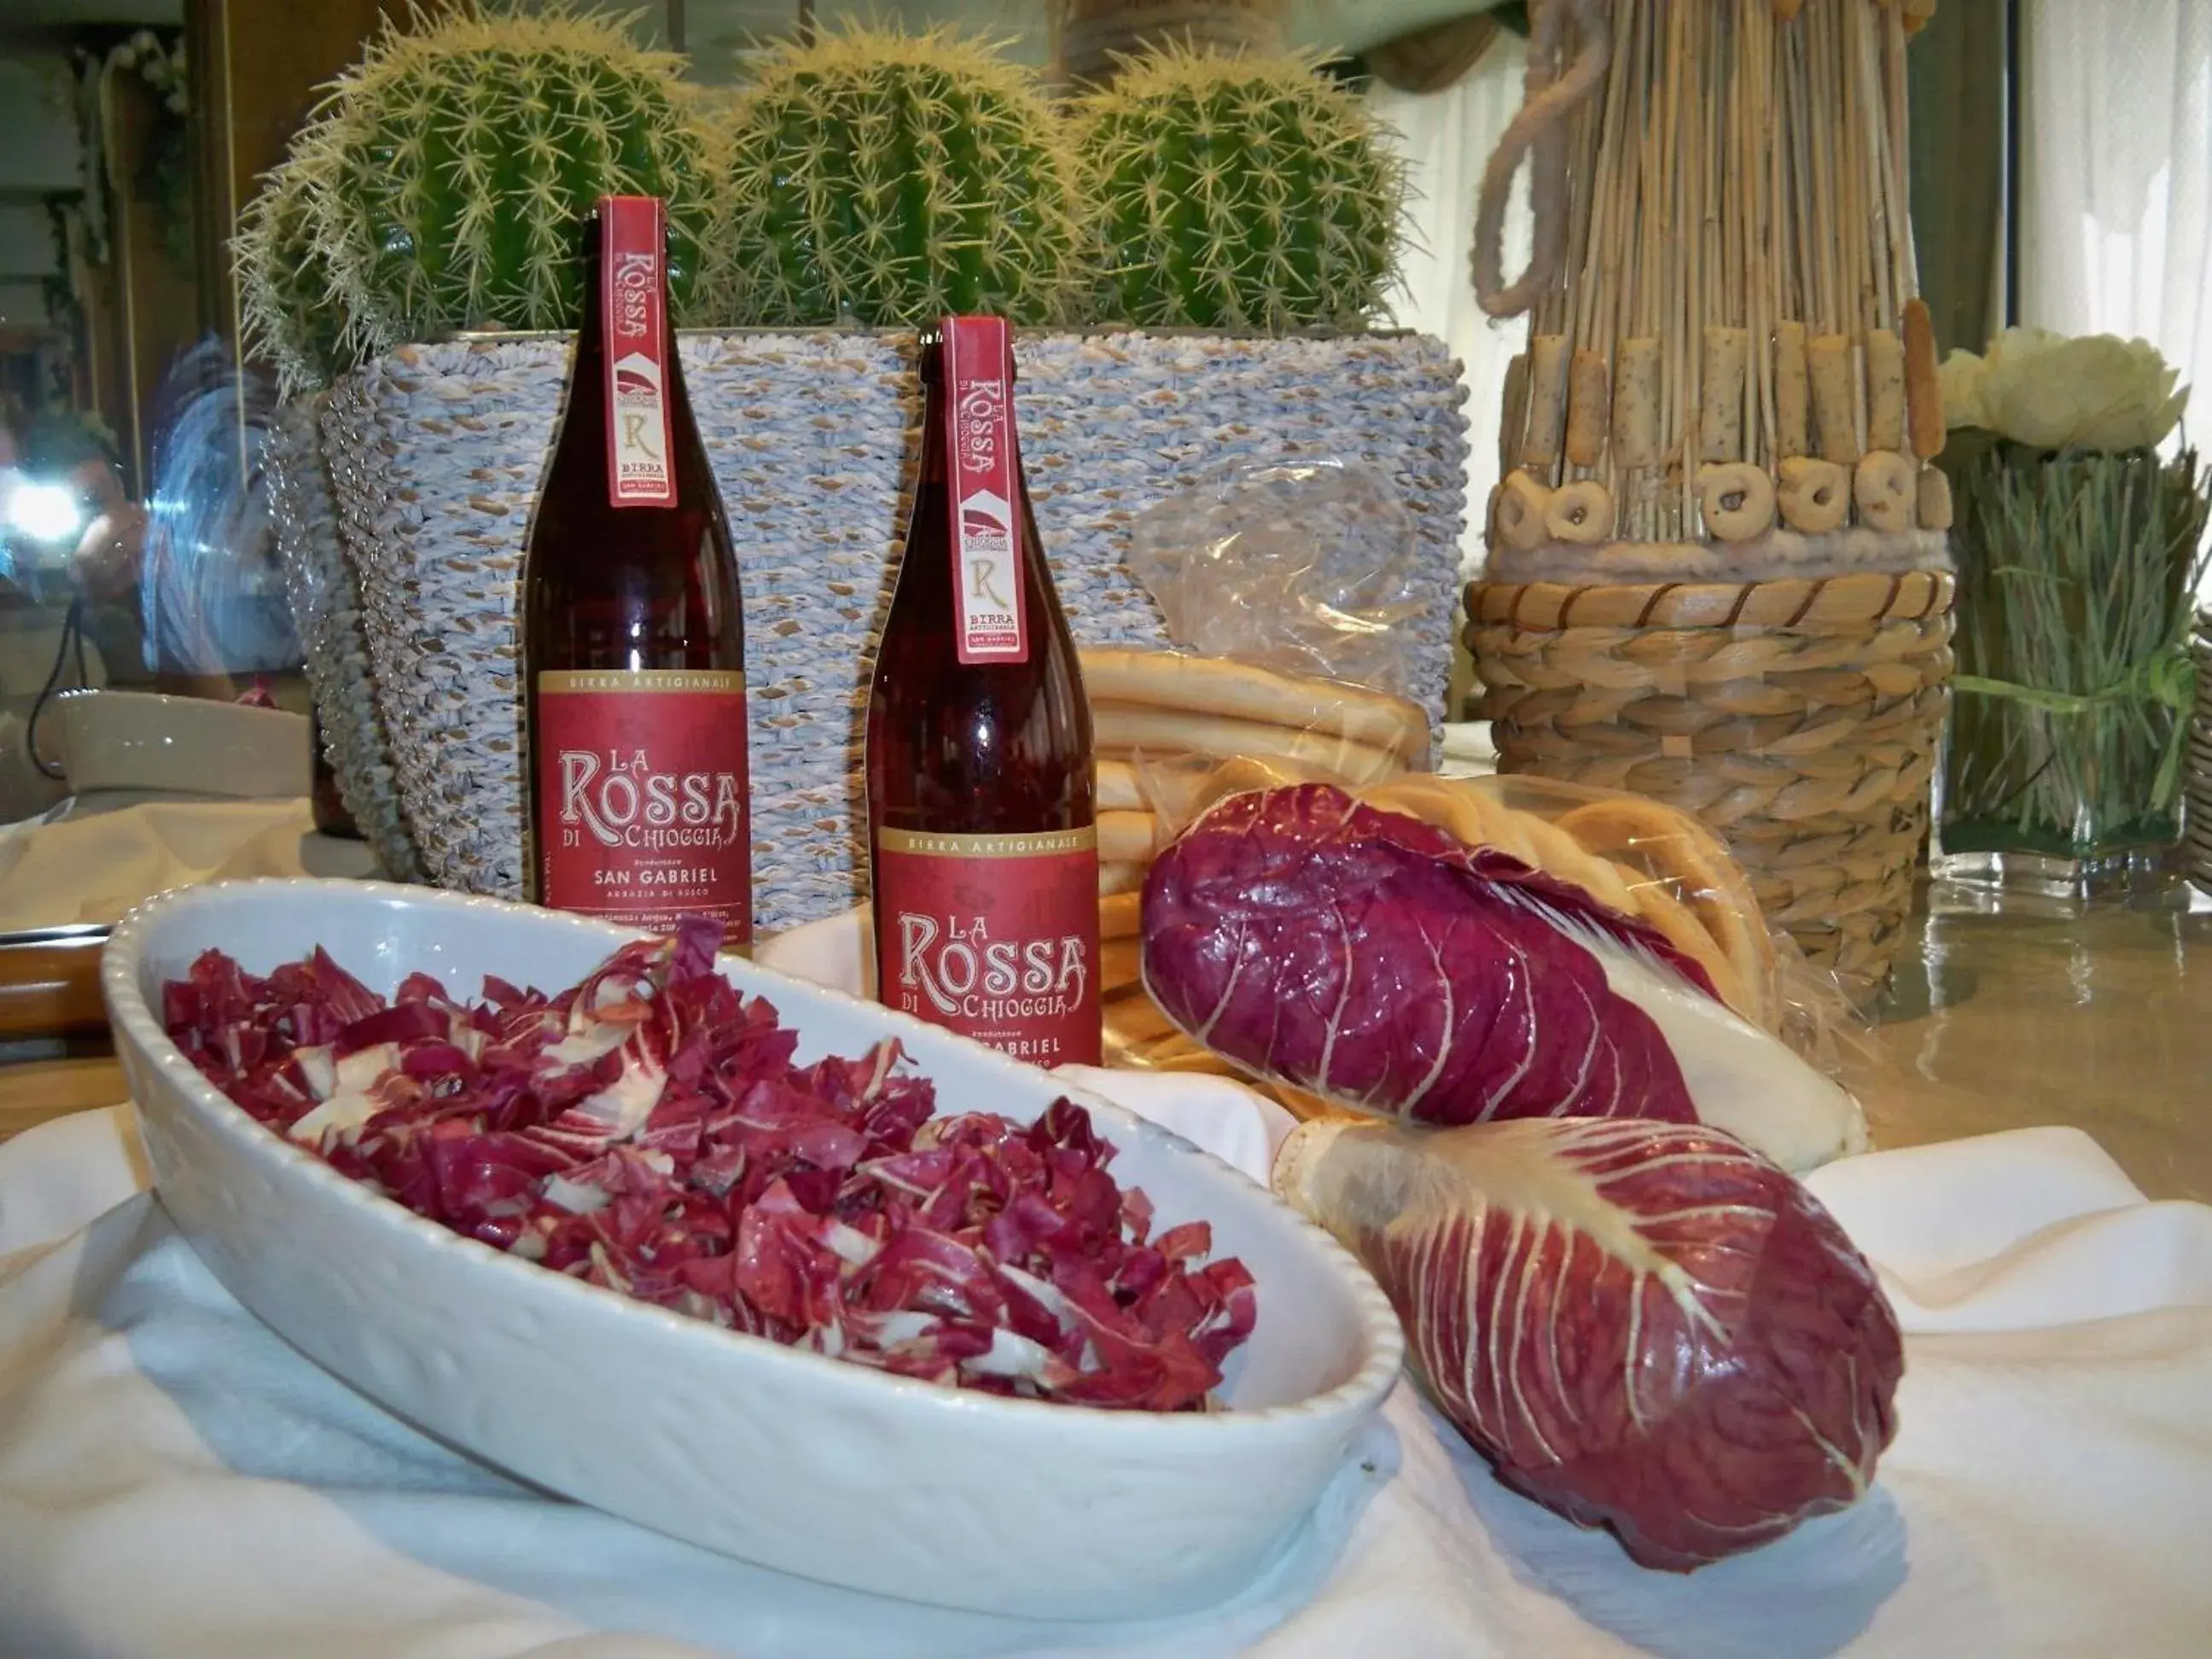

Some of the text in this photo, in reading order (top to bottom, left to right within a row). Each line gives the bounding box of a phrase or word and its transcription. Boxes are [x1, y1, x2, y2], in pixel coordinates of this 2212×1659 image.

[616, 253, 654, 337] ROSSA
[960, 379, 1001, 473] ROSSA
[622, 462, 663, 473] BIRRA
[969, 559, 1009, 610] R
[969, 614, 1015, 625] BIRRA
[569, 676, 620, 689] BIRRA
[609, 749, 649, 778] LA
[558, 748, 741, 847] ROSSA
[563, 824, 725, 853] DI CHIOGGIA
[908, 838, 960, 853] BIRRA
[594, 867, 718, 885] SAN GABRIEL
[949, 915, 988, 948] LA
[898, 911, 1086, 1017] ROSSA
[902, 992, 1068, 1024] DI CHIOGGIA
